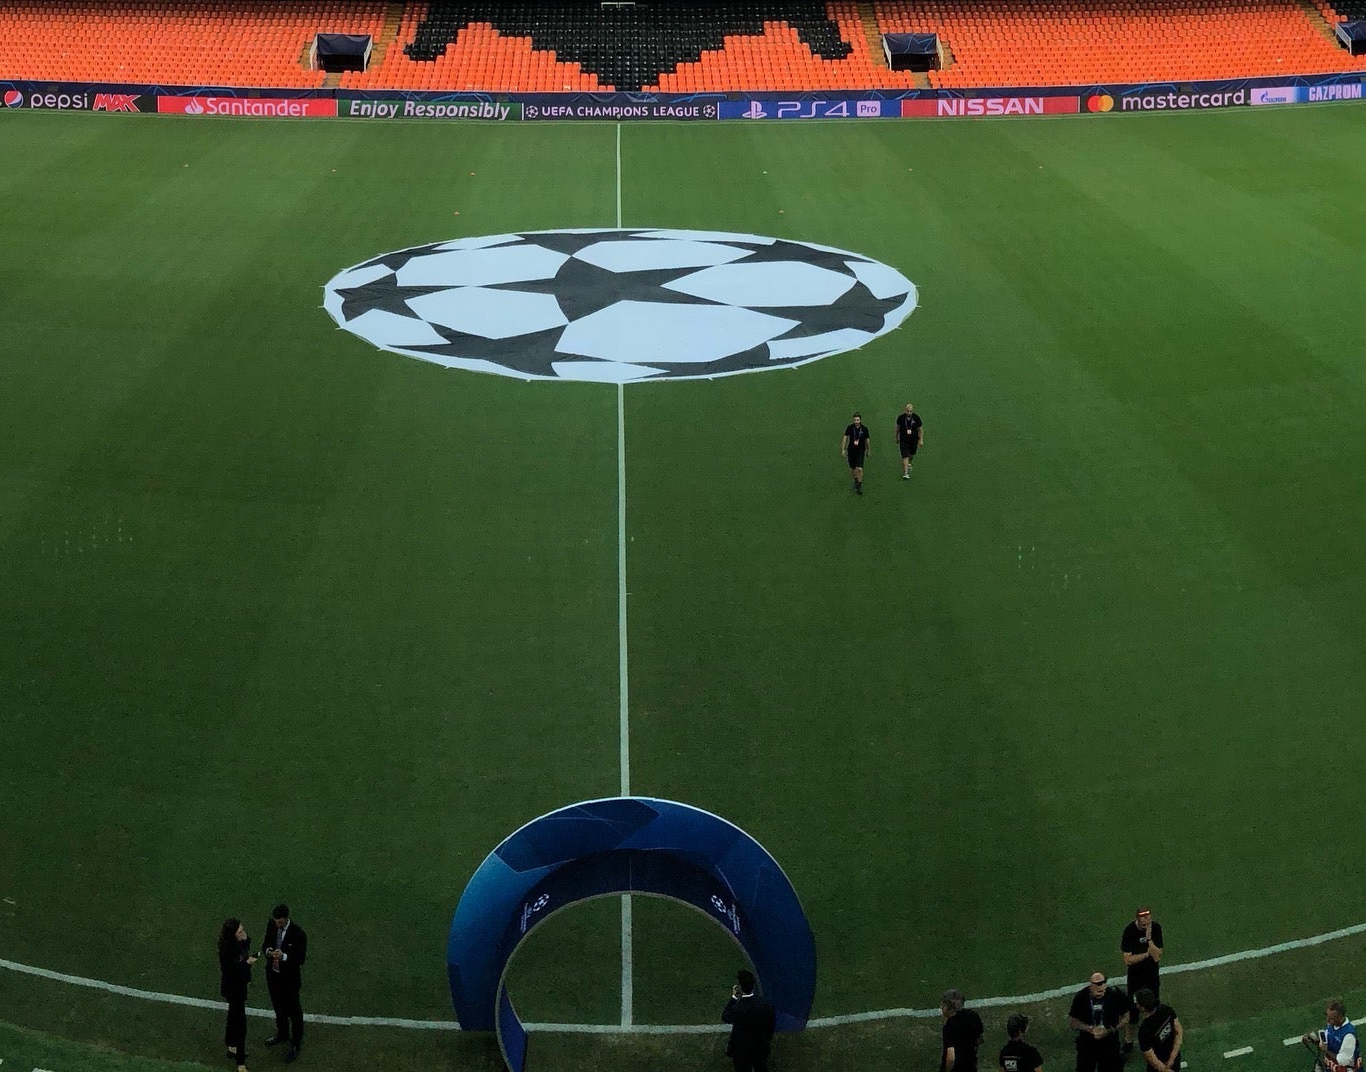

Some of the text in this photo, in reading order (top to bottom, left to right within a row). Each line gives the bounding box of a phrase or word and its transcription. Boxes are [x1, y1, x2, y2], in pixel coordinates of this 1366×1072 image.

[1122, 89, 1245, 110] mastercard
[1309, 83, 1362, 101] GAZPROM
[30, 93, 142, 113] pepsi MAX
[206, 98, 309, 117] Santander
[349, 100, 510, 121] Enjoy Responsibly
[541, 106, 700, 117] UEFA CHAMPIONS LEAGUE
[777, 101, 877, 118] PS4 Pro
[937, 97, 1044, 116] NISSAN
